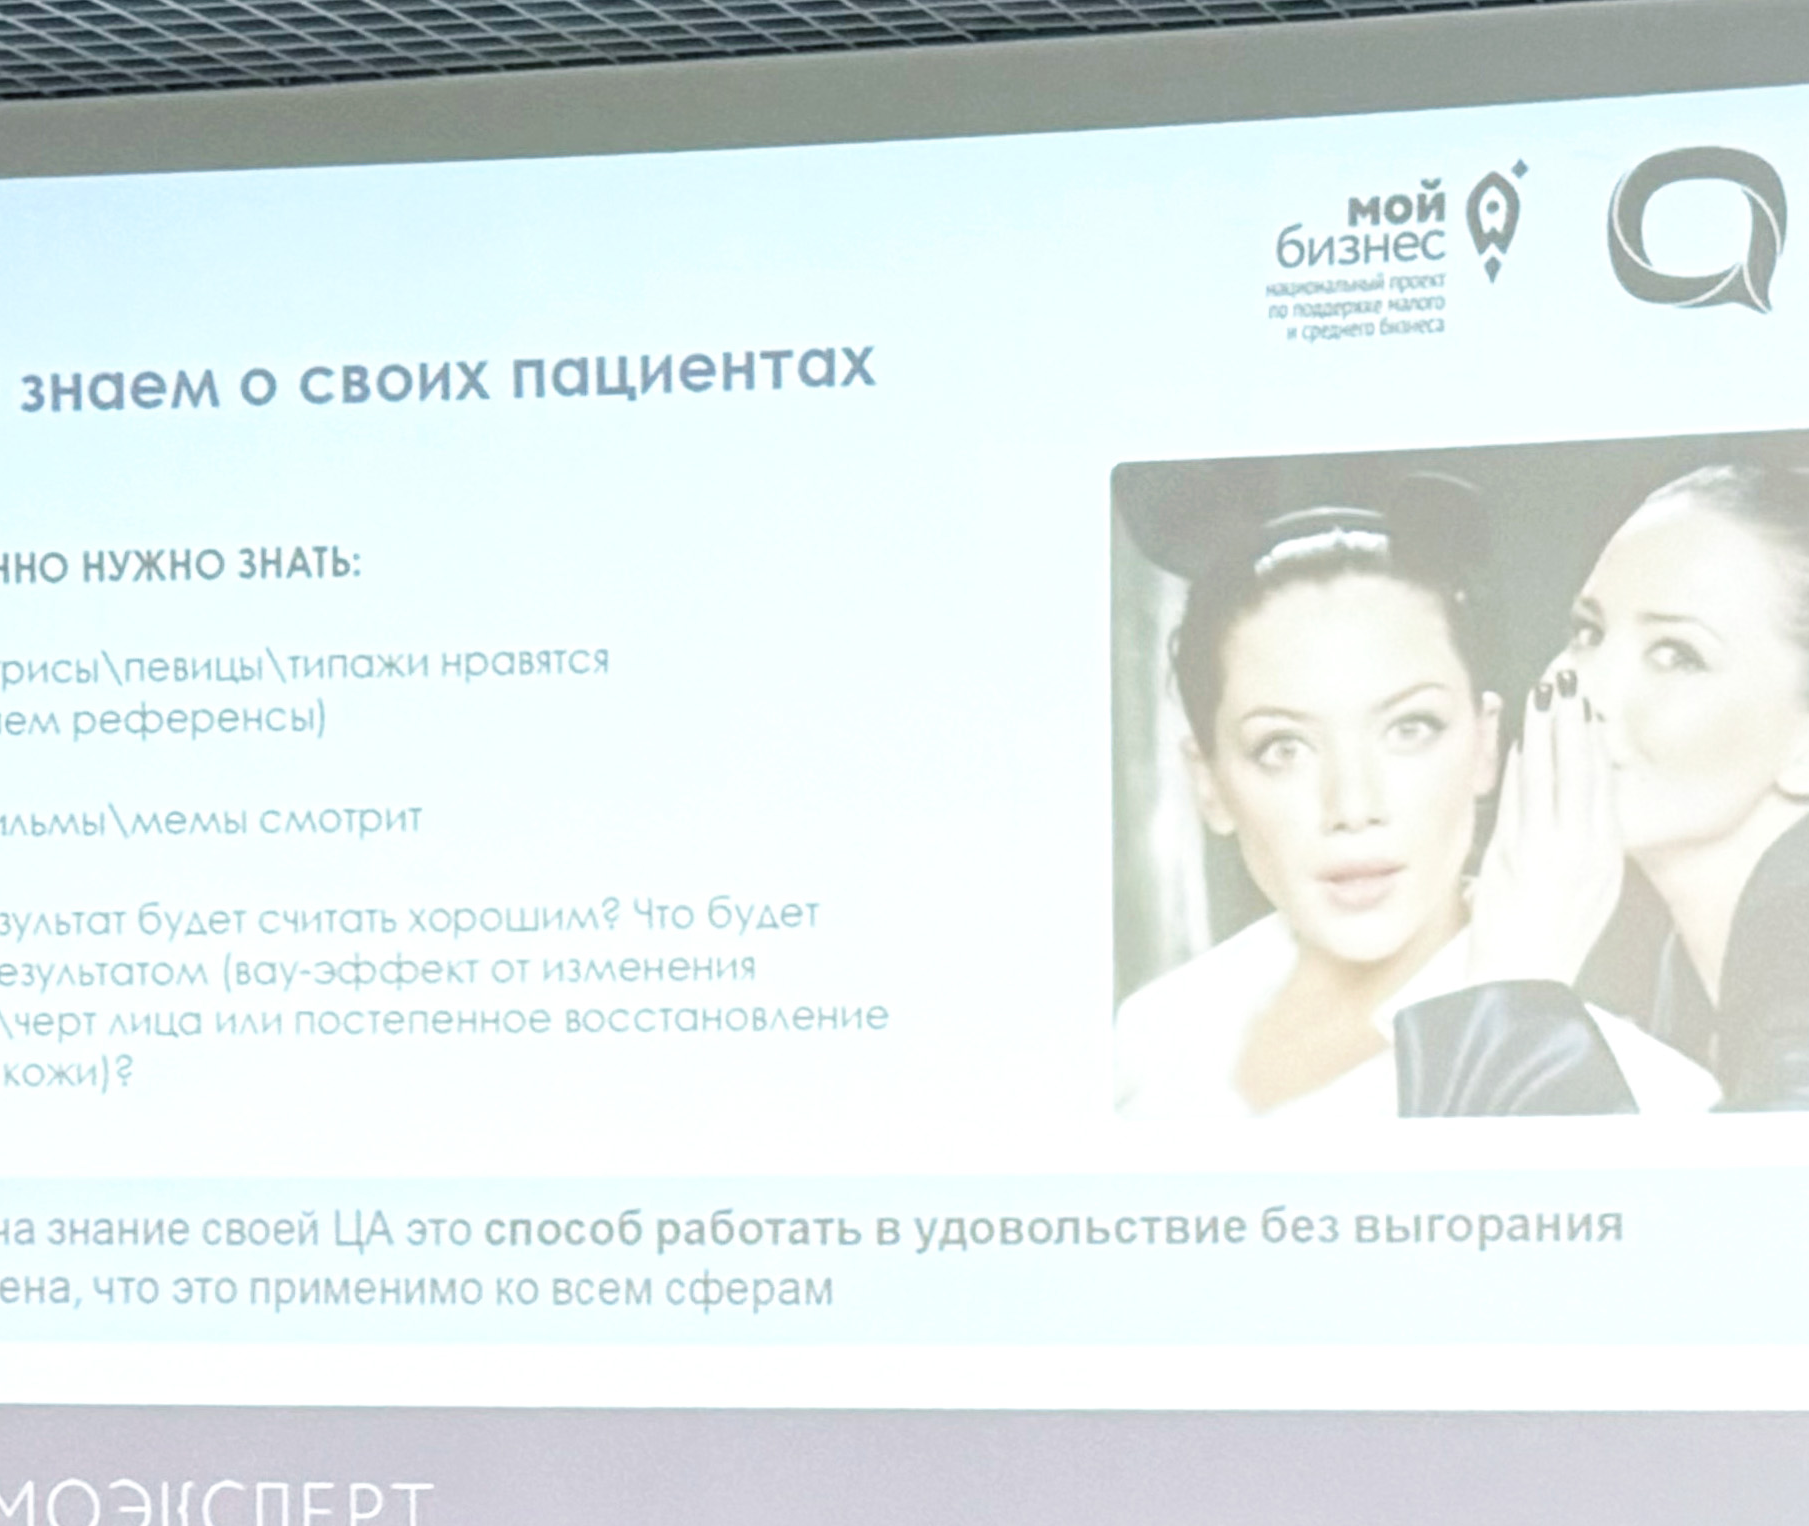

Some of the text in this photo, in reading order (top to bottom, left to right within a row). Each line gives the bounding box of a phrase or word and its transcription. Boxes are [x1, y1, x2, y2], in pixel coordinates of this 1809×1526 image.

[1347, 177, 1446, 227] мой
[1276, 223, 1446, 268] бизнес
[21, 369, 219, 412] знаем
[241, 367, 277, 405] о
[300, 360, 490, 404] своих
[514, 344, 875, 402] пациентах
[83, 548, 224, 582] НУЖНО
[239, 545, 362, 579] ЗНАТЬ:
[442, 645, 609, 682] нравятся
[73, 697, 325, 742] референсы)
[260, 805, 422, 839] смотрит
[138, 901, 246, 942] будет
[259, 909, 397, 935] считать
[409, 896, 620, 939] хорошим?
[633, 897, 694, 930] Что
[708, 895, 820, 935] будет
[223, 951, 479, 993] (вау-эффект
[492, 957, 530, 984] от
[543, 956, 756, 983] изменения
[109, 1010, 202, 1038] лица
[216, 1010, 282, 1036] или
[295, 1008, 552, 1036] постепенное
[566, 1005, 890, 1034] восстановление
[3, 1053, 133, 1094] кожи)?
[47, 1217, 190, 1246] знание
[202, 1209, 319, 1246] своей
[334, 1208, 395, 1256] ЦА
[407, 1217, 472, 1247] это
[484, 1208, 643, 1247] способ
[656, 1206, 863, 1256] работать
[876, 1216, 902, 1245] в
[913, 1215, 1247, 1255] удовольствие
[1261, 1204, 1340, 1244] без
[1355, 1212, 1623, 1252] выгорания
[93, 1276, 159, 1305] что
[172, 1276, 238, 1305] это
[250, 1276, 483, 1314] применимо
[496, 1277, 540, 1306] ко
[552, 1277, 652, 1306] всем
[665, 1268, 833, 1315] сферам
